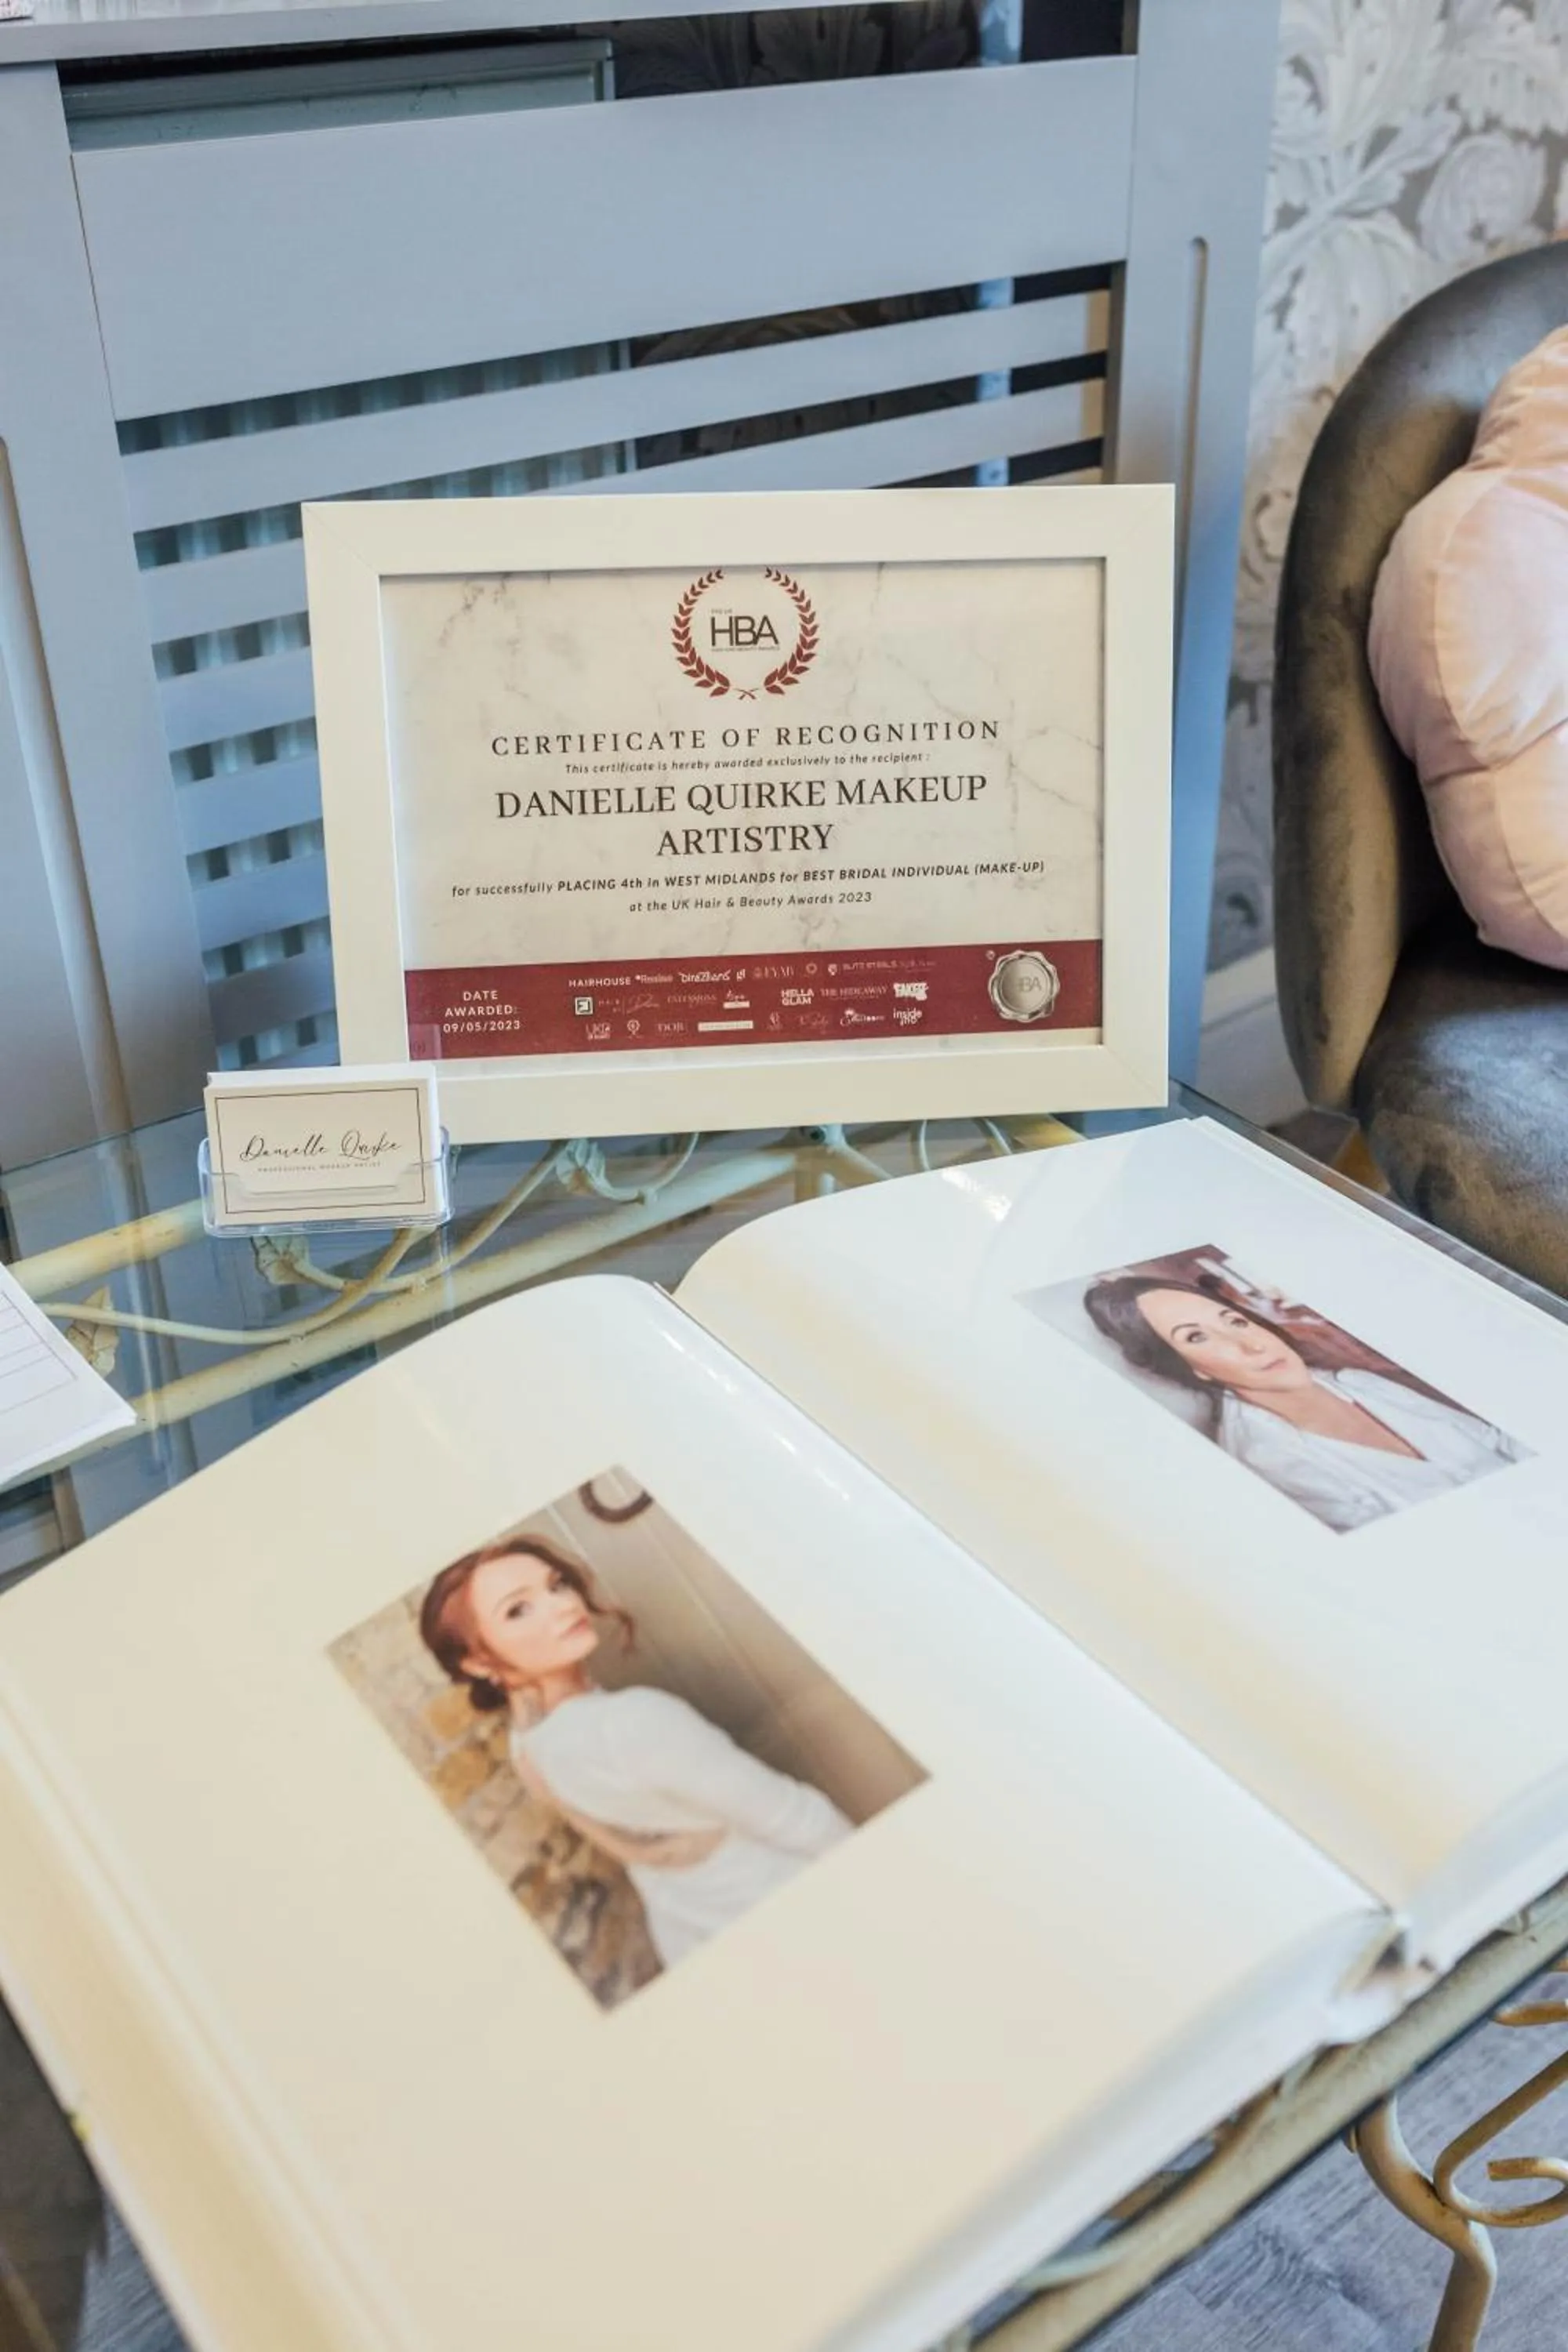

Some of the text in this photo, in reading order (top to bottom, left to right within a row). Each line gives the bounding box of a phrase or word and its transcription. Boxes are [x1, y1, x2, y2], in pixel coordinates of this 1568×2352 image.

[711, 615, 779, 647] HBA
[491, 720, 999, 757] CERTIFICATE OF RECOGNITION
[564, 763, 590, 775] This
[591, 760, 655, 774] certificate
[657, 760, 668, 772] is
[670, 758, 710, 771] hereby
[713, 757, 764, 769] awarded
[766, 755, 831, 767] exclusively
[833, 755, 847, 765] to
[849, 753, 869, 764] the
[871, 752, 923, 765] recipient
[496, 775, 987, 819] DANIELLE QUIRKE MAKEUP
[655, 823, 835, 857] ARTISTRY
[452, 858, 1045, 898] for successfully PLACING 4th in WEST MIDLANDS for BEST BRIDAL INDIVIDUAL (MAKE-UP)
[629, 891, 873, 913] at the UK Hair & Beauty Awards 2023
[568, 977, 631, 988] HAIRHOUSE
[781, 988, 815, 998] HELLA
[463, 989, 499, 1001] DATE
[782, 996, 811, 1006] GLAM
[443, 1020, 521, 1033] 09/05/2023
